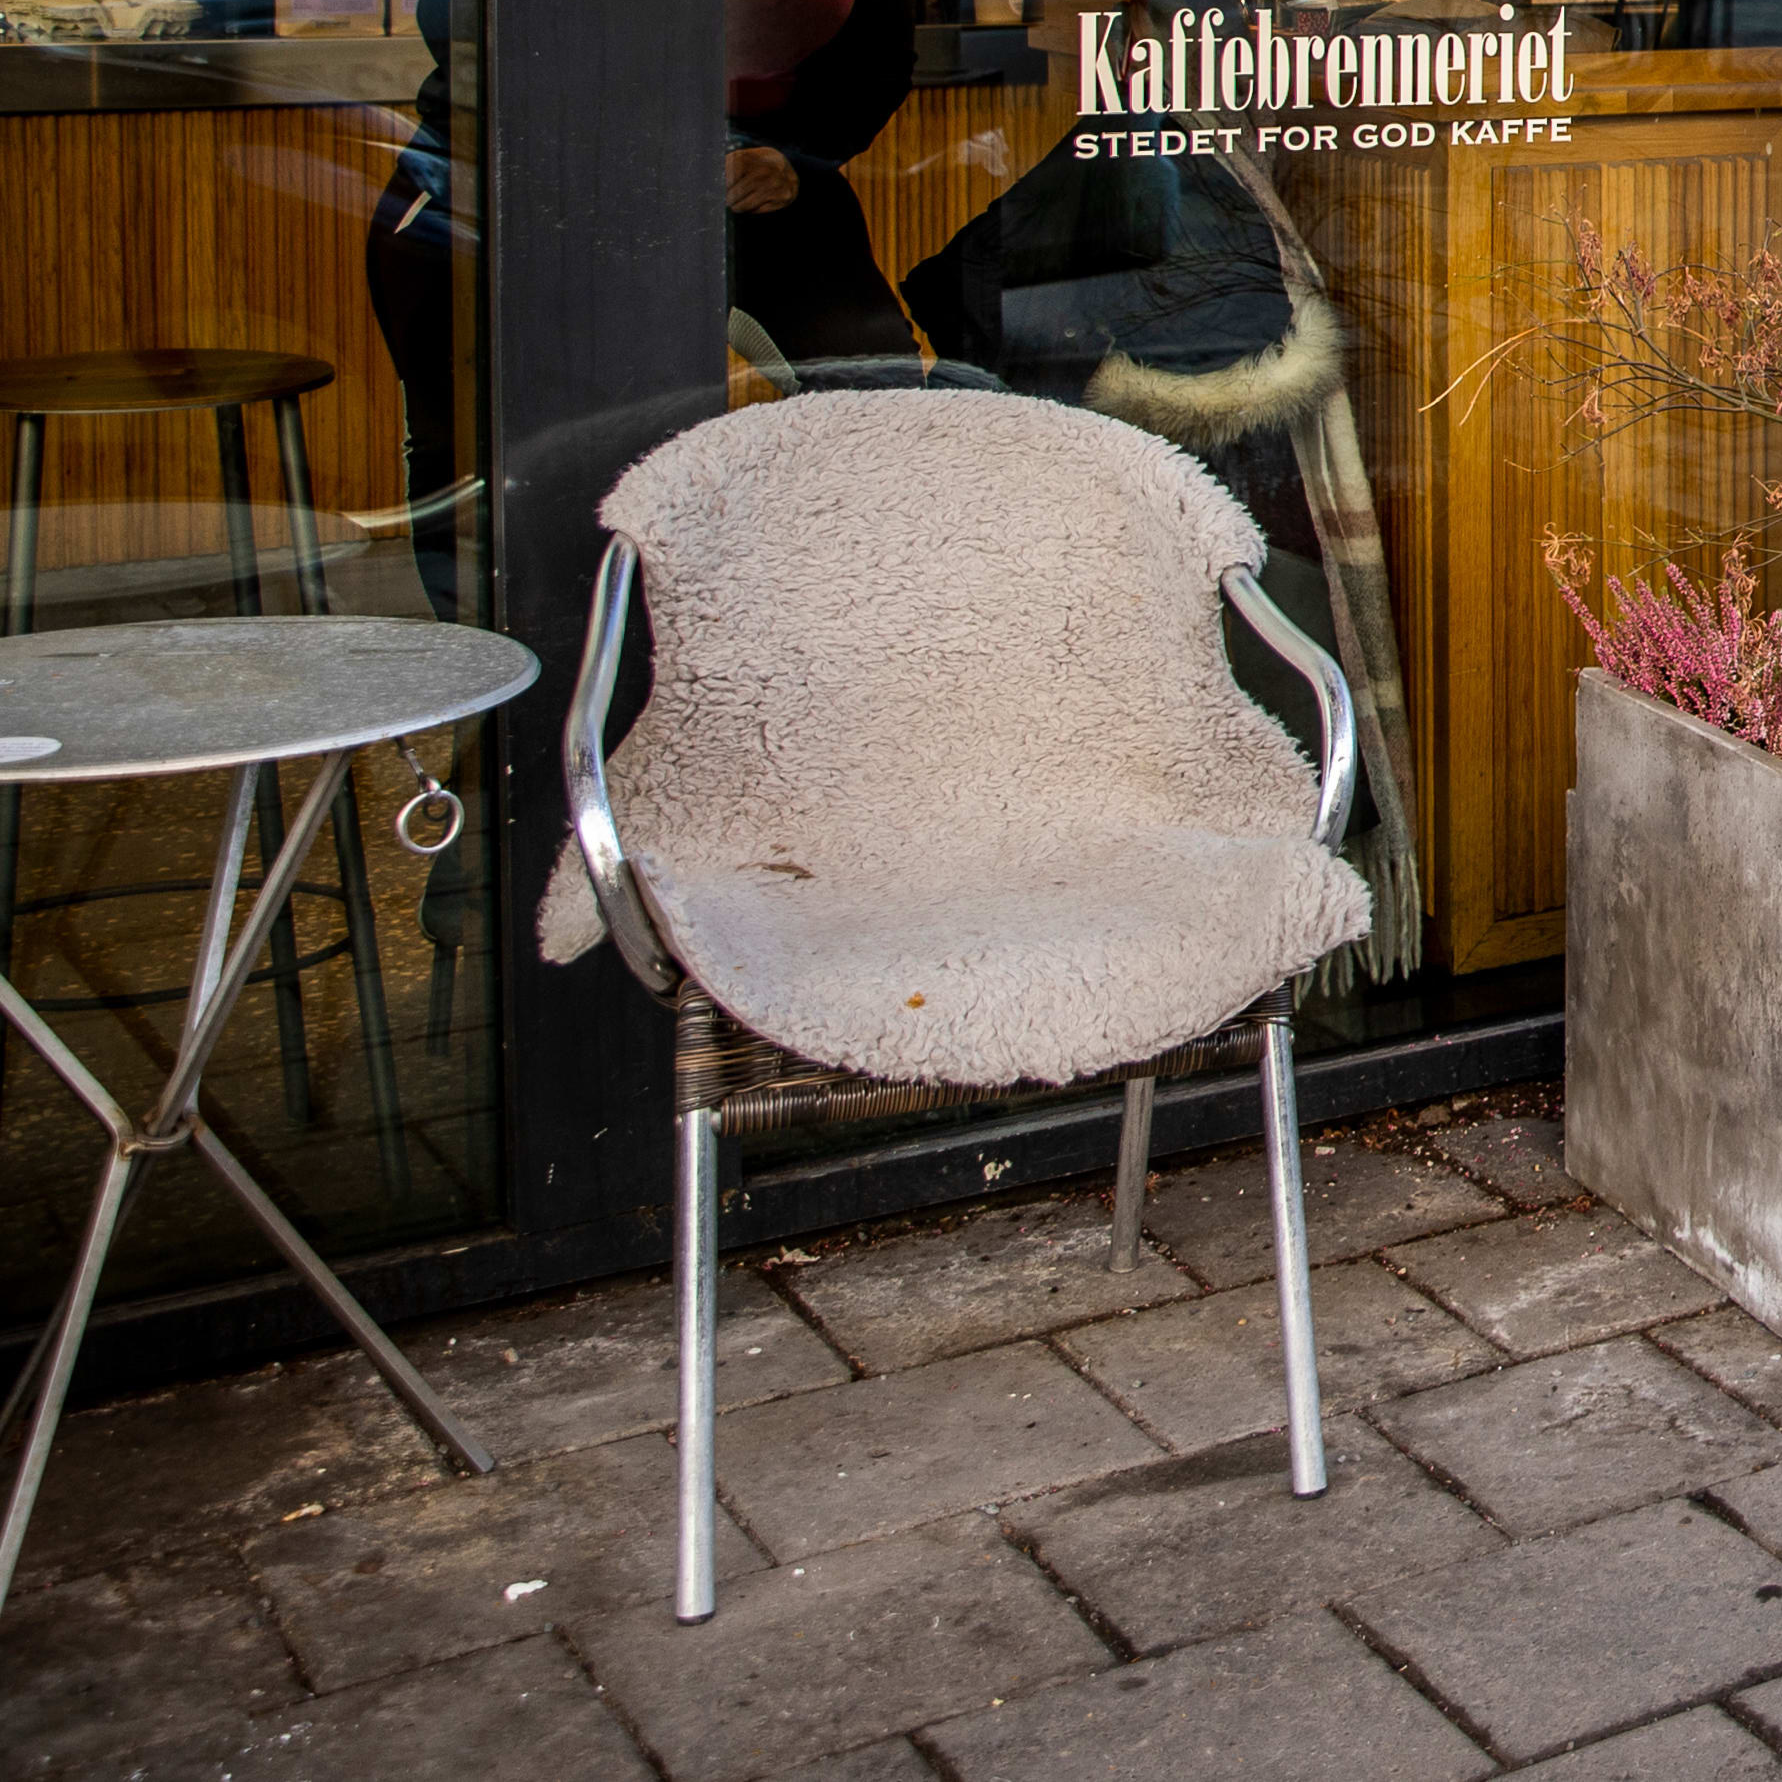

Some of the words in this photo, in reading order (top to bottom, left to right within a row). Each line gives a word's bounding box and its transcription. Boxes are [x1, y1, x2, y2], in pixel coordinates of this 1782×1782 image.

[1075, 3, 1574, 117] Kaffebrenneriet
[1073, 129, 1243, 160] STEDET
[1256, 124, 1338, 153] FOR
[1352, 121, 1436, 149] GOD
[1450, 116, 1573, 148] KAFFE
